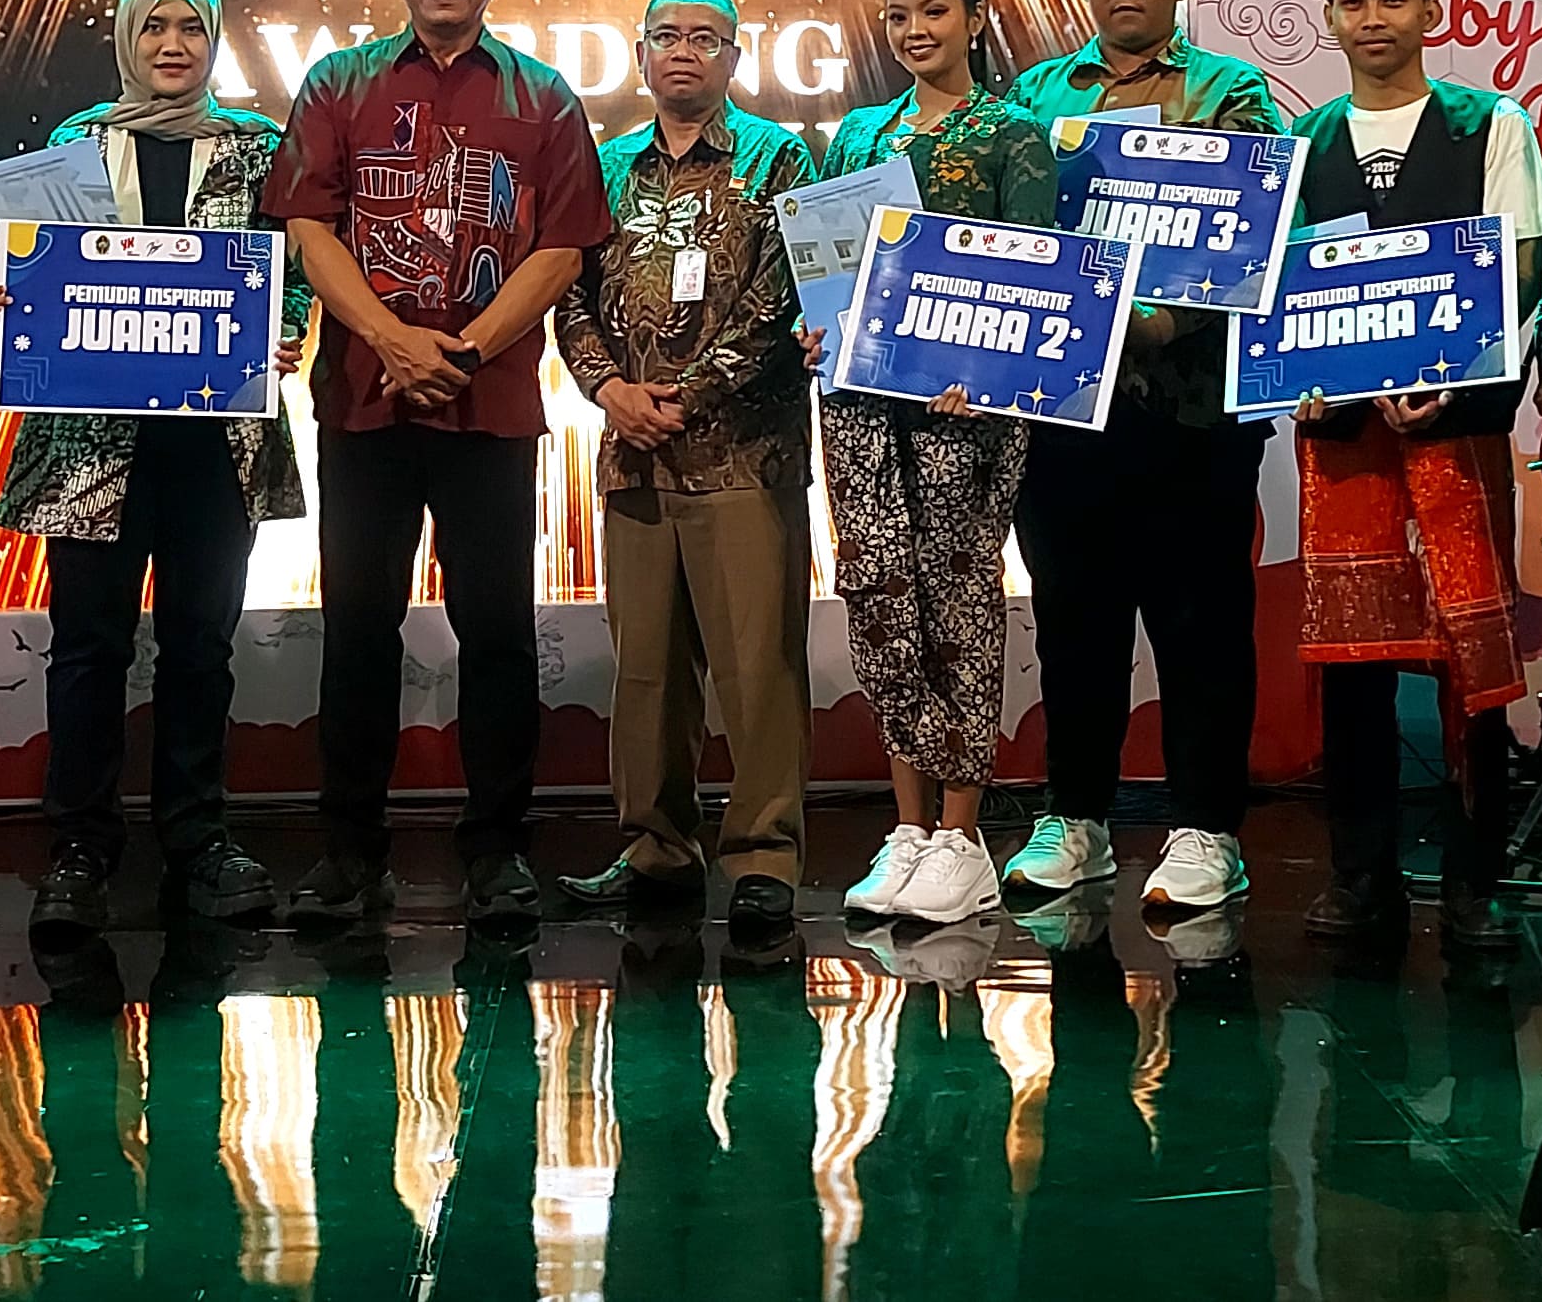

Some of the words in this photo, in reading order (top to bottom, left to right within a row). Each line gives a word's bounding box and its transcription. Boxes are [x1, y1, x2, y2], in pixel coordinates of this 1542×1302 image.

[1088, 177, 1158, 201] PEMUDA
[1159, 183, 1243, 208] INSPIRATIF
[1075, 198, 1202, 248] JUARA
[1207, 211, 1239, 251] 3
[64, 284, 140, 305] PEMUDA
[144, 286, 236, 309] INSPIRATIF
[910, 271, 982, 299] PEMUDA
[985, 281, 1074, 312] INSPIRATIF
[1285, 285, 1360, 312] PEMUDA
[1363, 272, 1456, 301] INSPIRATIF
[61, 307, 201, 354] JUARA
[214, 312, 232, 356] 1
[894, 294, 1031, 354] JUARA
[1035, 315, 1071, 361] 2
[1276, 298, 1417, 353] JUARA
[1427, 293, 1462, 333] 4
